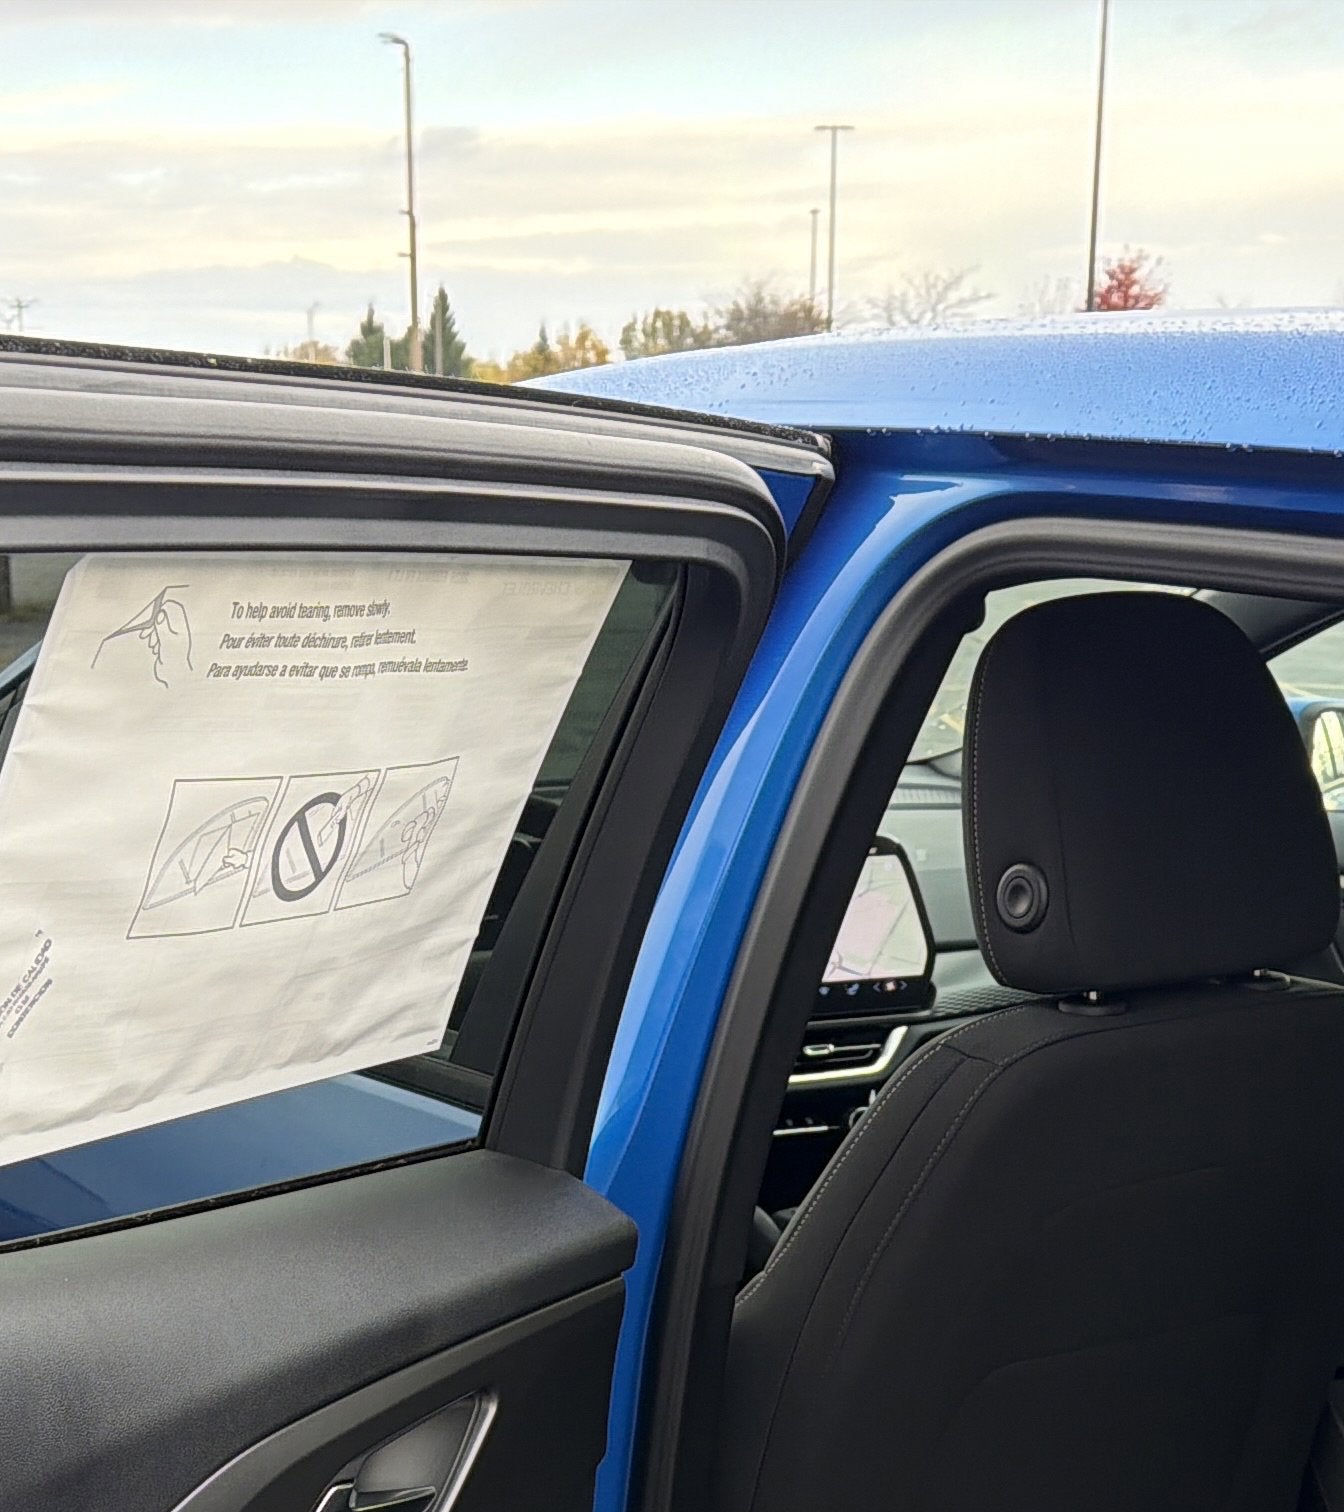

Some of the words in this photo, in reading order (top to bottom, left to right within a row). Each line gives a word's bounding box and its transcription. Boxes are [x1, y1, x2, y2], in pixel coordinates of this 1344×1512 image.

[231, 601, 244, 619] To
[245, 601, 268, 622] help
[269, 601, 297, 619] avoid
[297, 601, 332, 622] tearing,
[333, 604, 366, 618] remove
[219, 633, 245, 649] Pour
[245, 632, 275, 649] éviter
[274, 633, 301, 648] toute
[301, 632, 349, 651] déchirure,
[206, 662, 232, 678] Para
[232, 661, 279, 680] ayudarse
[279, 664, 288, 677] a
[289, 662, 318, 678] evitar
[318, 665, 339, 680] que
[339, 664, 351, 678] se
[378, 656, 423, 674] remuévala
